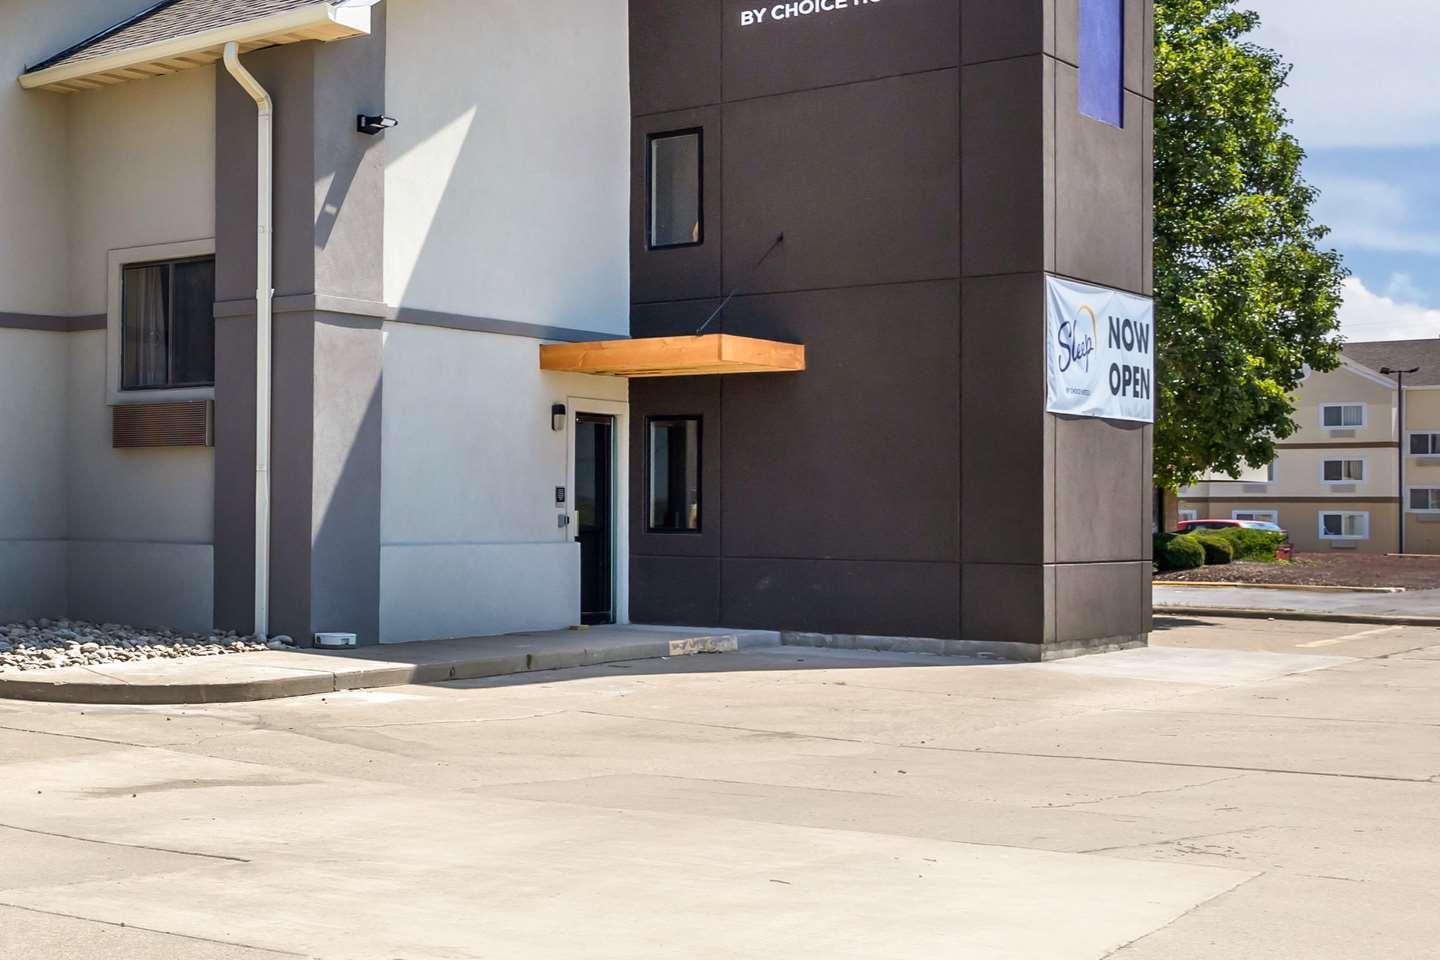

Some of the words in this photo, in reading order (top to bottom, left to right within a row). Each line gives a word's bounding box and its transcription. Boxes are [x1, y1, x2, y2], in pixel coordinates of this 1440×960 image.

[740, 7, 767, 27] BY
[1057, 319, 1095, 374] Sleep
[1107, 315, 1151, 355] NOW
[1108, 361, 1151, 401] OPEN
